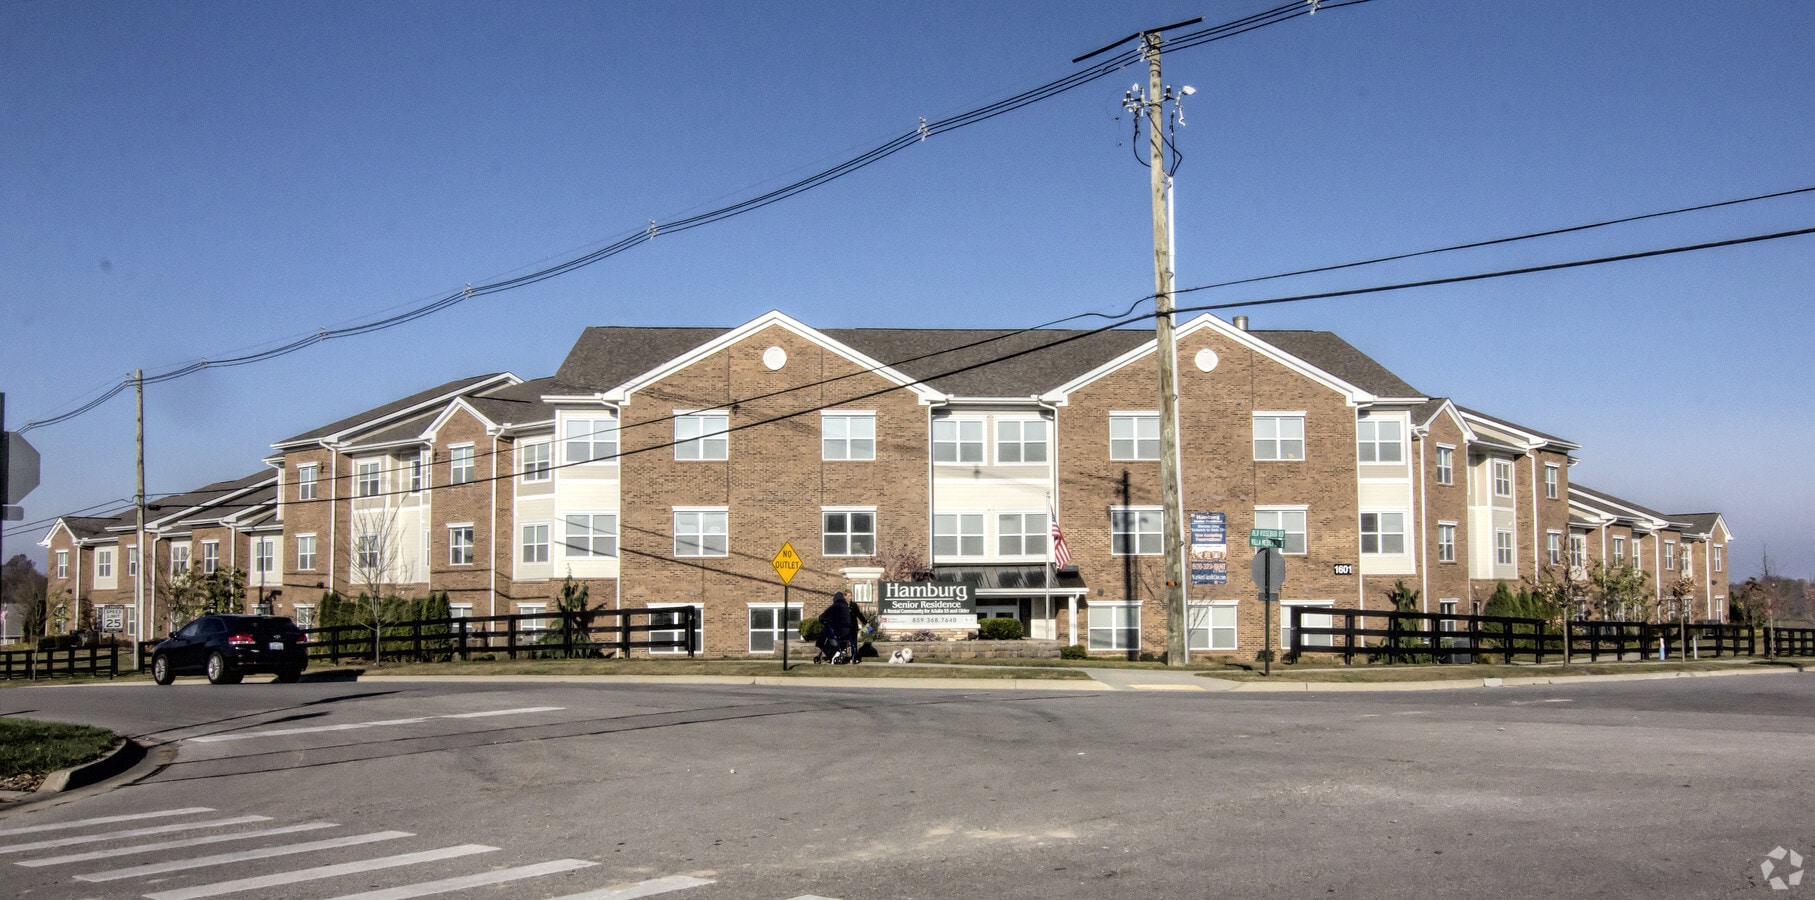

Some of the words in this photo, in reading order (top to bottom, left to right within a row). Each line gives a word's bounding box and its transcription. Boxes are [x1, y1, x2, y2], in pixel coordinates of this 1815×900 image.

[775, 561, 799, 569] OUTLET
[1334, 565, 1352, 574] 1601
[886, 582, 968, 600] Hamburg
[106, 619, 121, 627] 25
